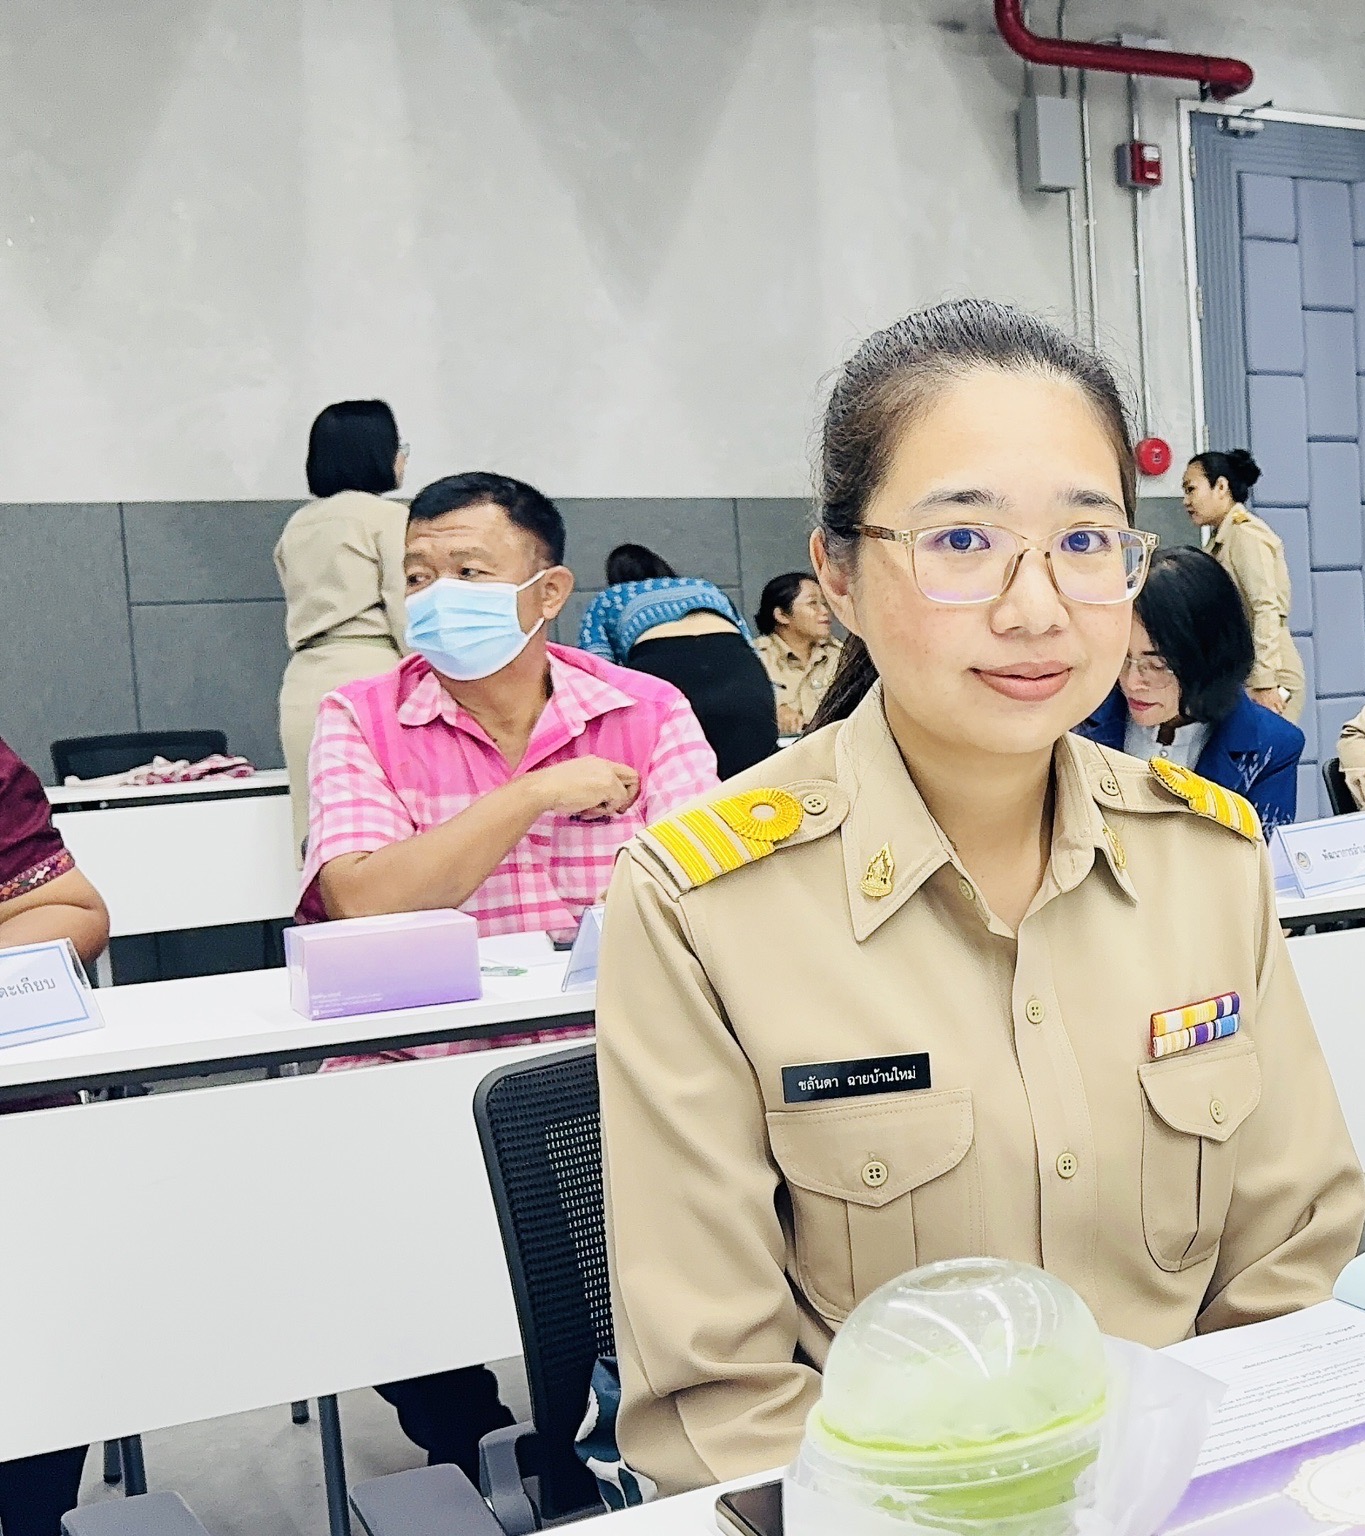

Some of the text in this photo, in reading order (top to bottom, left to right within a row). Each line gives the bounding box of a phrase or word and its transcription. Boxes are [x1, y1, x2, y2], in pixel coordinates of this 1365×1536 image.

[847, 1065, 916, 1086] ฉายบ้านใหม่
